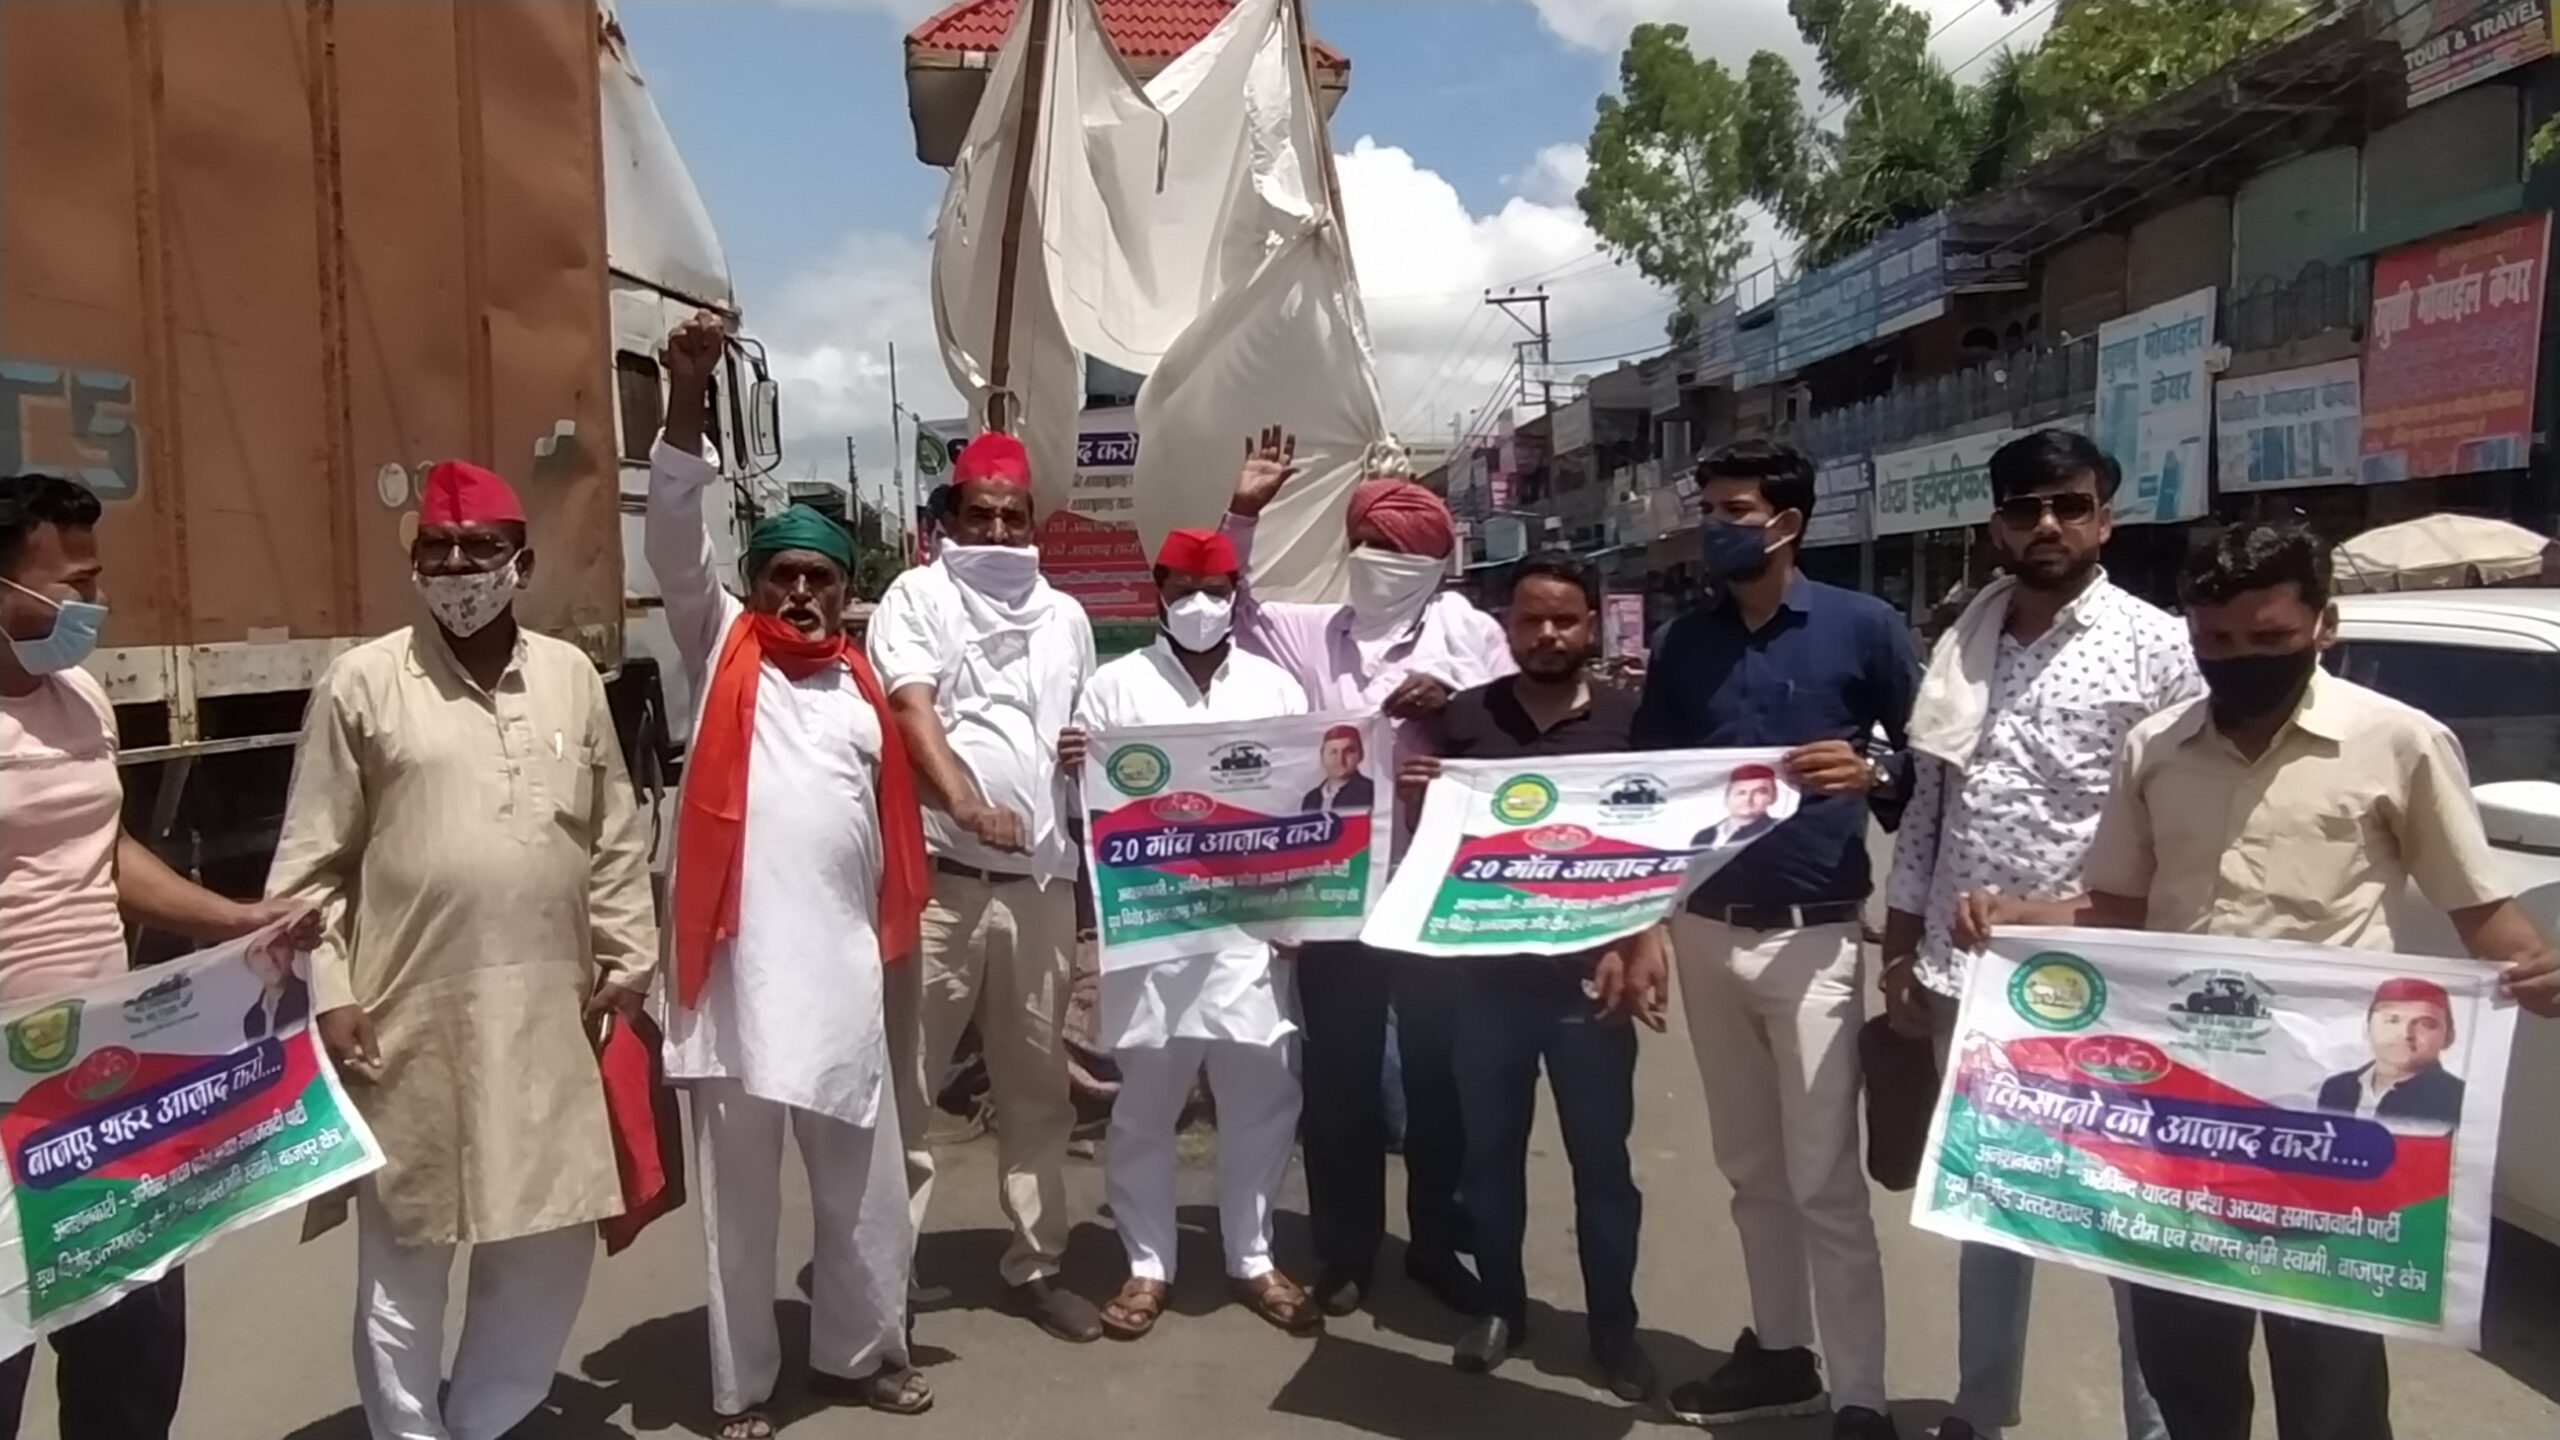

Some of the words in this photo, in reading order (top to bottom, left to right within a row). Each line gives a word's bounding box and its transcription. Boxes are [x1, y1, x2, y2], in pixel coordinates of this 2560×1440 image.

[2404, 38, 2450, 70] TOUR
[2454, 31, 2467, 50] &
[2470, 1, 2543, 42] TRAVEL
[1097, 432, 1137, 461] करो
[1109, 839, 1140, 863] 20
[1285, 812, 1335, 845] करो
[1461, 859, 1502, 880] 20
[99, 1104, 153, 1145] शहर
[2105, 1099, 2155, 1137] को
[2097, 1206, 2129, 1238] और
[2129, 1213, 2160, 1242] टीम
[2141, 1182, 2183, 1207] यादव
[2185, 1184, 2224, 1216] प्रदेश
[2227, 1197, 2278, 1224] अध्यक्ष
[2281, 1206, 2363, 1236] समाजवादी
[2367, 1212, 2402, 1243] पार्टी
